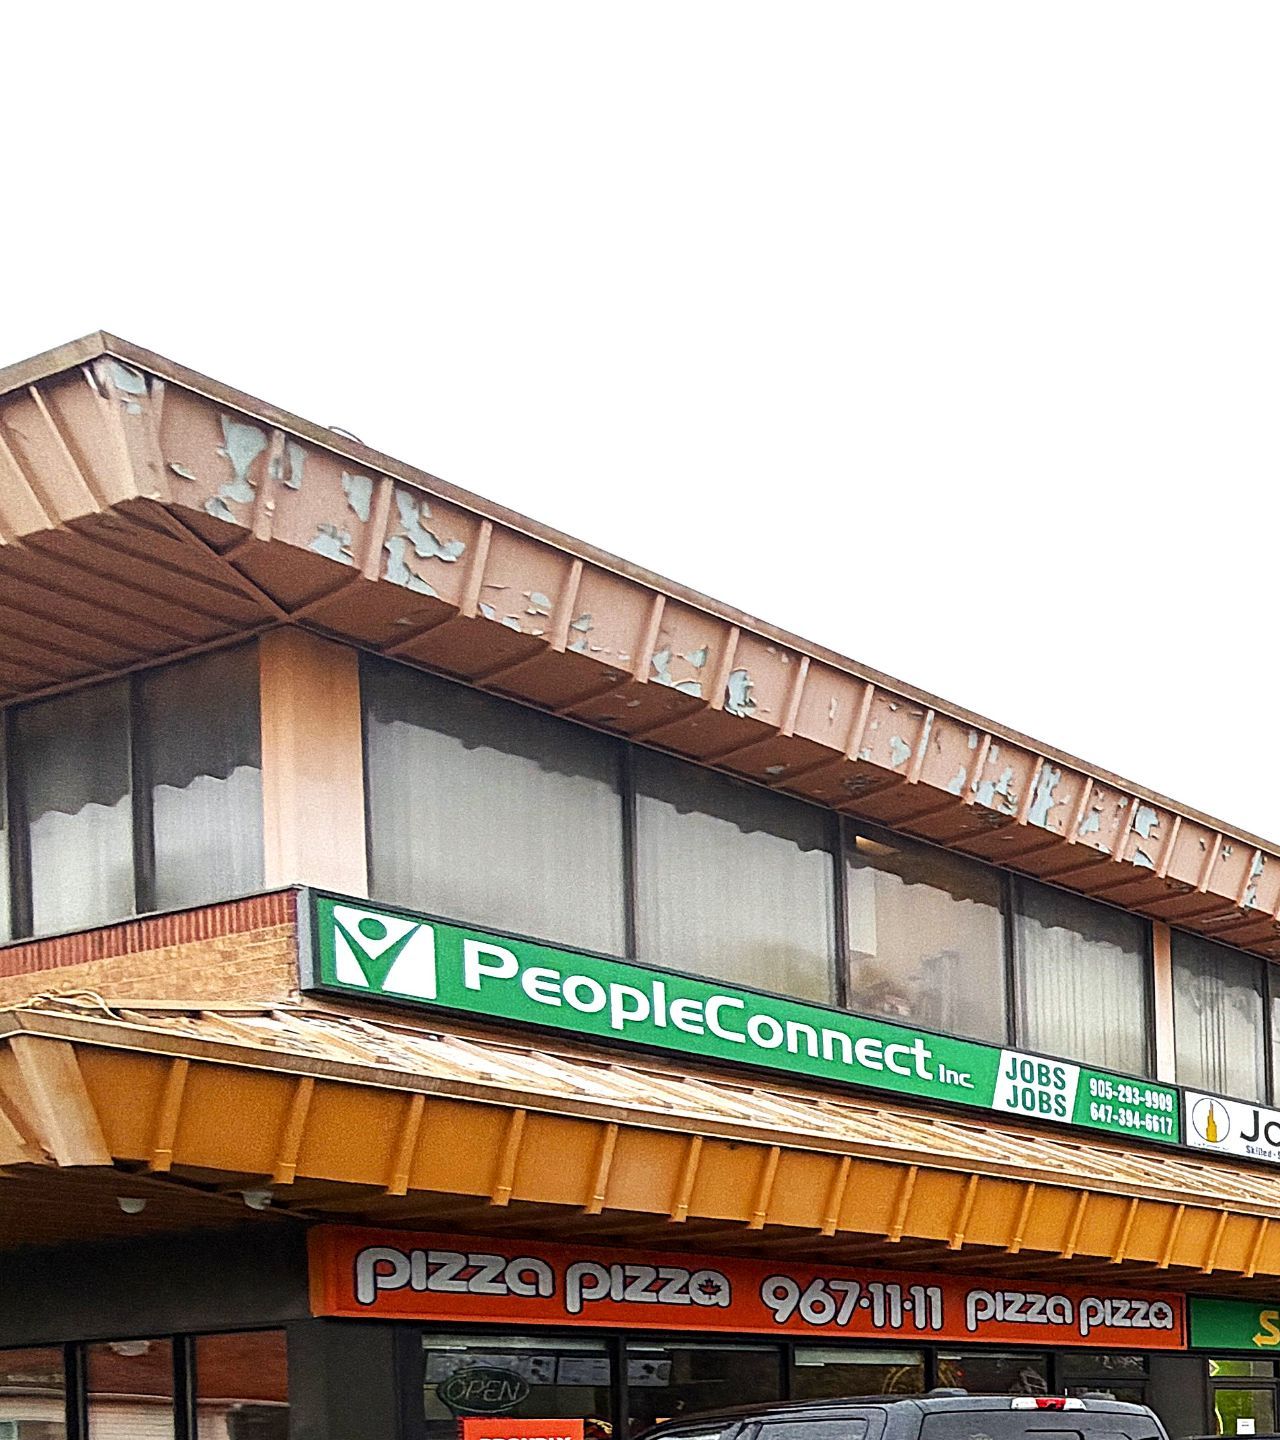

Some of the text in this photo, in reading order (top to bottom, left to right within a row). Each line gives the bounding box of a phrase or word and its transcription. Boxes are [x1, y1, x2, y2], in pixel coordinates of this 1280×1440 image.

[464, 938, 933, 1081] PeopleConnect
[1005, 1057, 1066, 1090] JOBS
[1006, 1085, 1067, 1117] JOBS
[1089, 1078, 1173, 1112] 905-293-9909
[1090, 1102, 1173, 1135] 647-394-6617
[1246, 1145, 1272, 1158] Skilled
[355, 1246, 554, 1306] pizza
[565, 1260, 732, 1314] pizza
[966, 1289, 1074, 1332] pizza
[1079, 1297, 1174, 1336] pizza
[445, 1379, 522, 1402] OPEN
